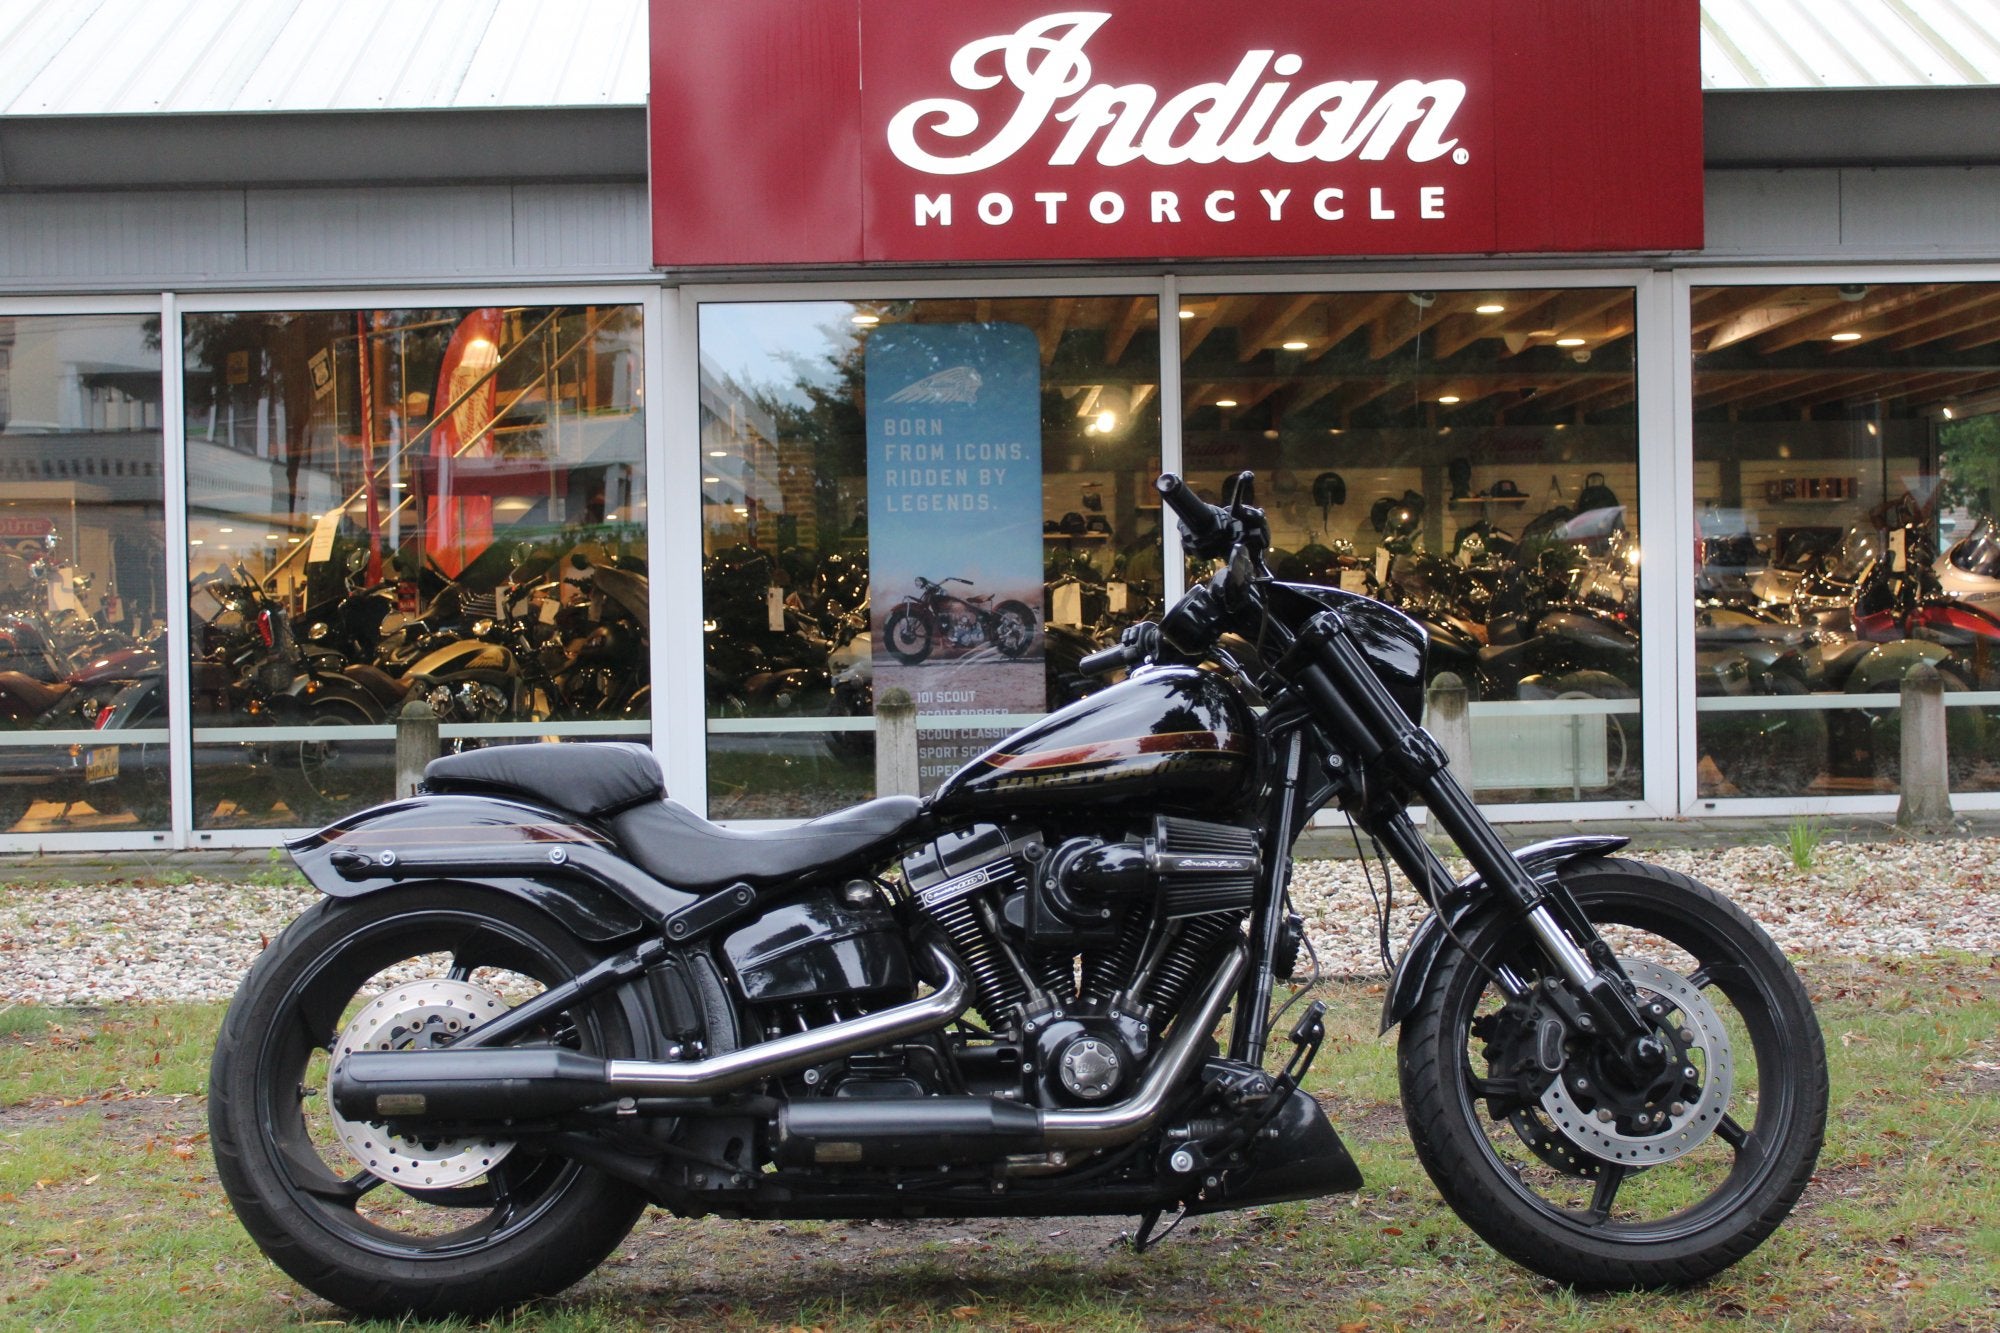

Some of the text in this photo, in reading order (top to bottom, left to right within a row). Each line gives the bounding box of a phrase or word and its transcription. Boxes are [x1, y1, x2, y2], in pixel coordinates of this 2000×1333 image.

[887, 12, 1467, 175] Indian
[914, 187, 1446, 226] MOTORCYCLE
[884, 418, 943, 436] BORN
[885, 443, 1031, 462] FROM ICONS.
[886, 468, 1007, 487] RIDDEN BY
[886, 494, 998, 513] LEGENDS.
[917, 690, 976, 704] 101 SCOUT
[918, 727, 1012, 741] SCOUT CLASSIC
[919, 746, 958, 759] SPORT
